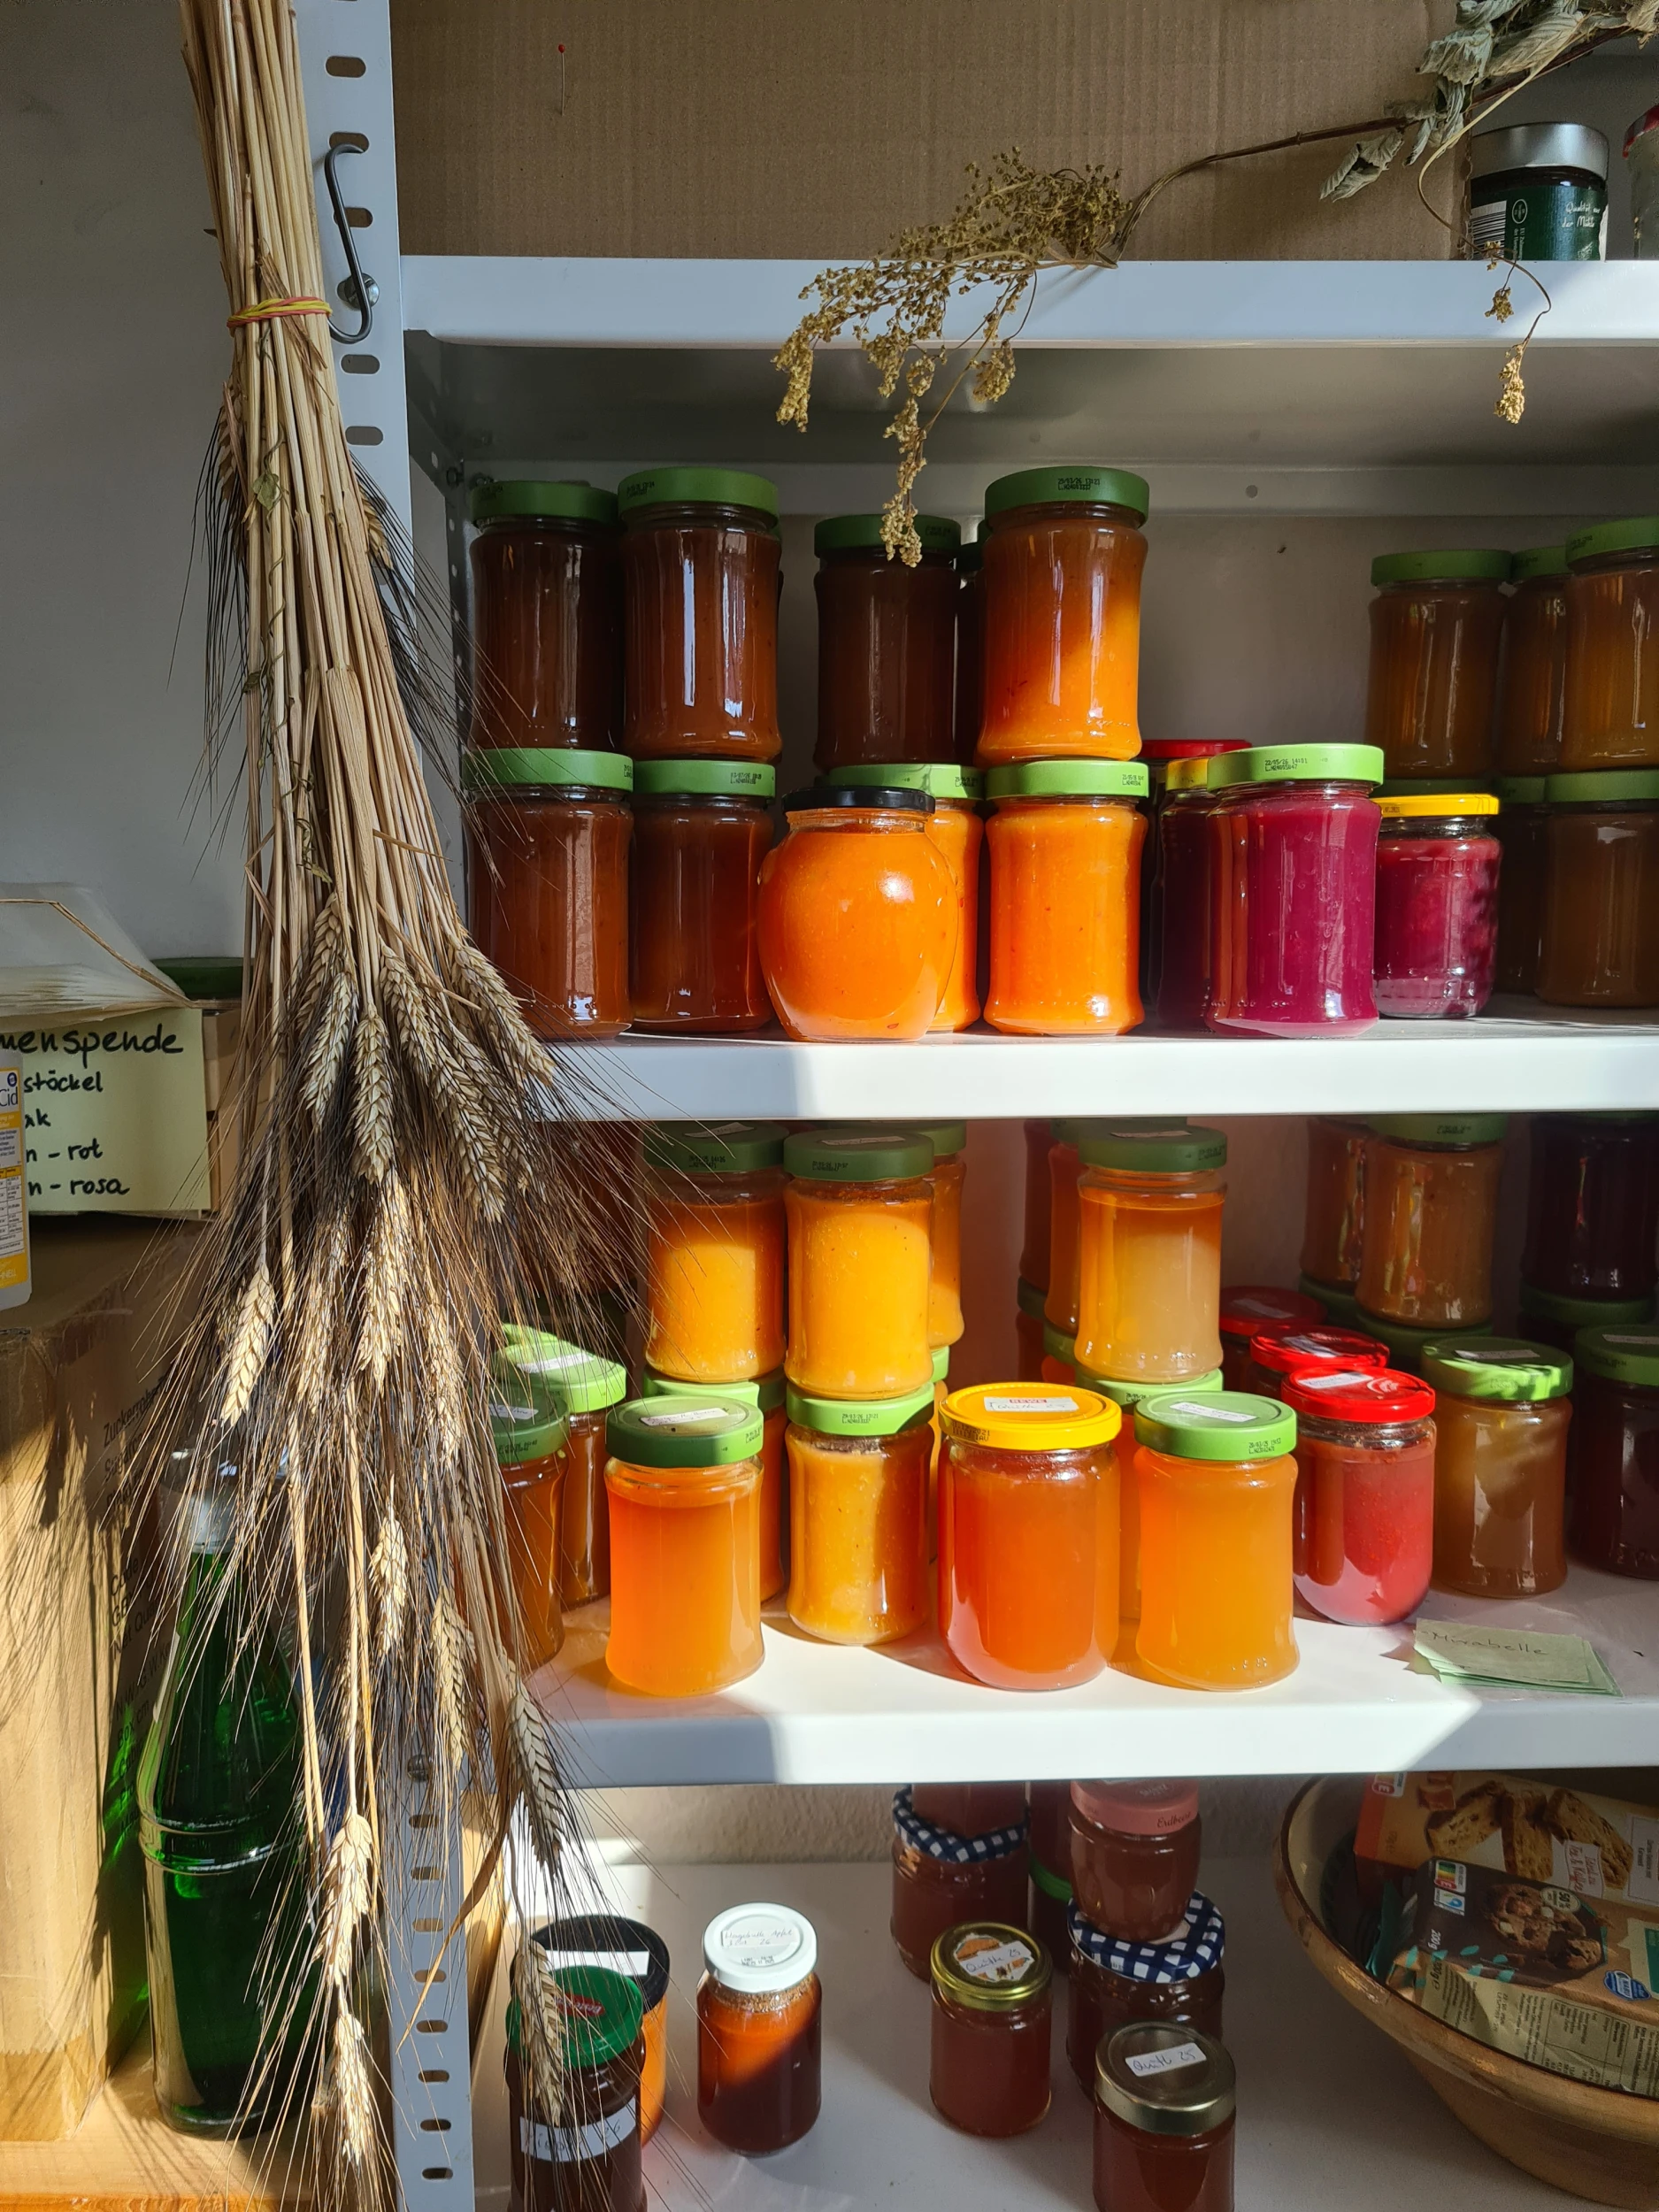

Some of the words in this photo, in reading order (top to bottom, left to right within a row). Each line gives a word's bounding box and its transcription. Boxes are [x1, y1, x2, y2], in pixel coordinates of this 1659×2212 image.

[1562, 217, 1574, 227] der
[67, 1137, 104, 1161] rot
[70, 1178, 130, 1195] rosa
[1432, 1632, 1549, 1655] Mirabelle
[1428, 1929, 1441, 1951] 200g
[1010, 1949, 1021, 1958] 25
[1179, 2048, 1196, 2062] 25
